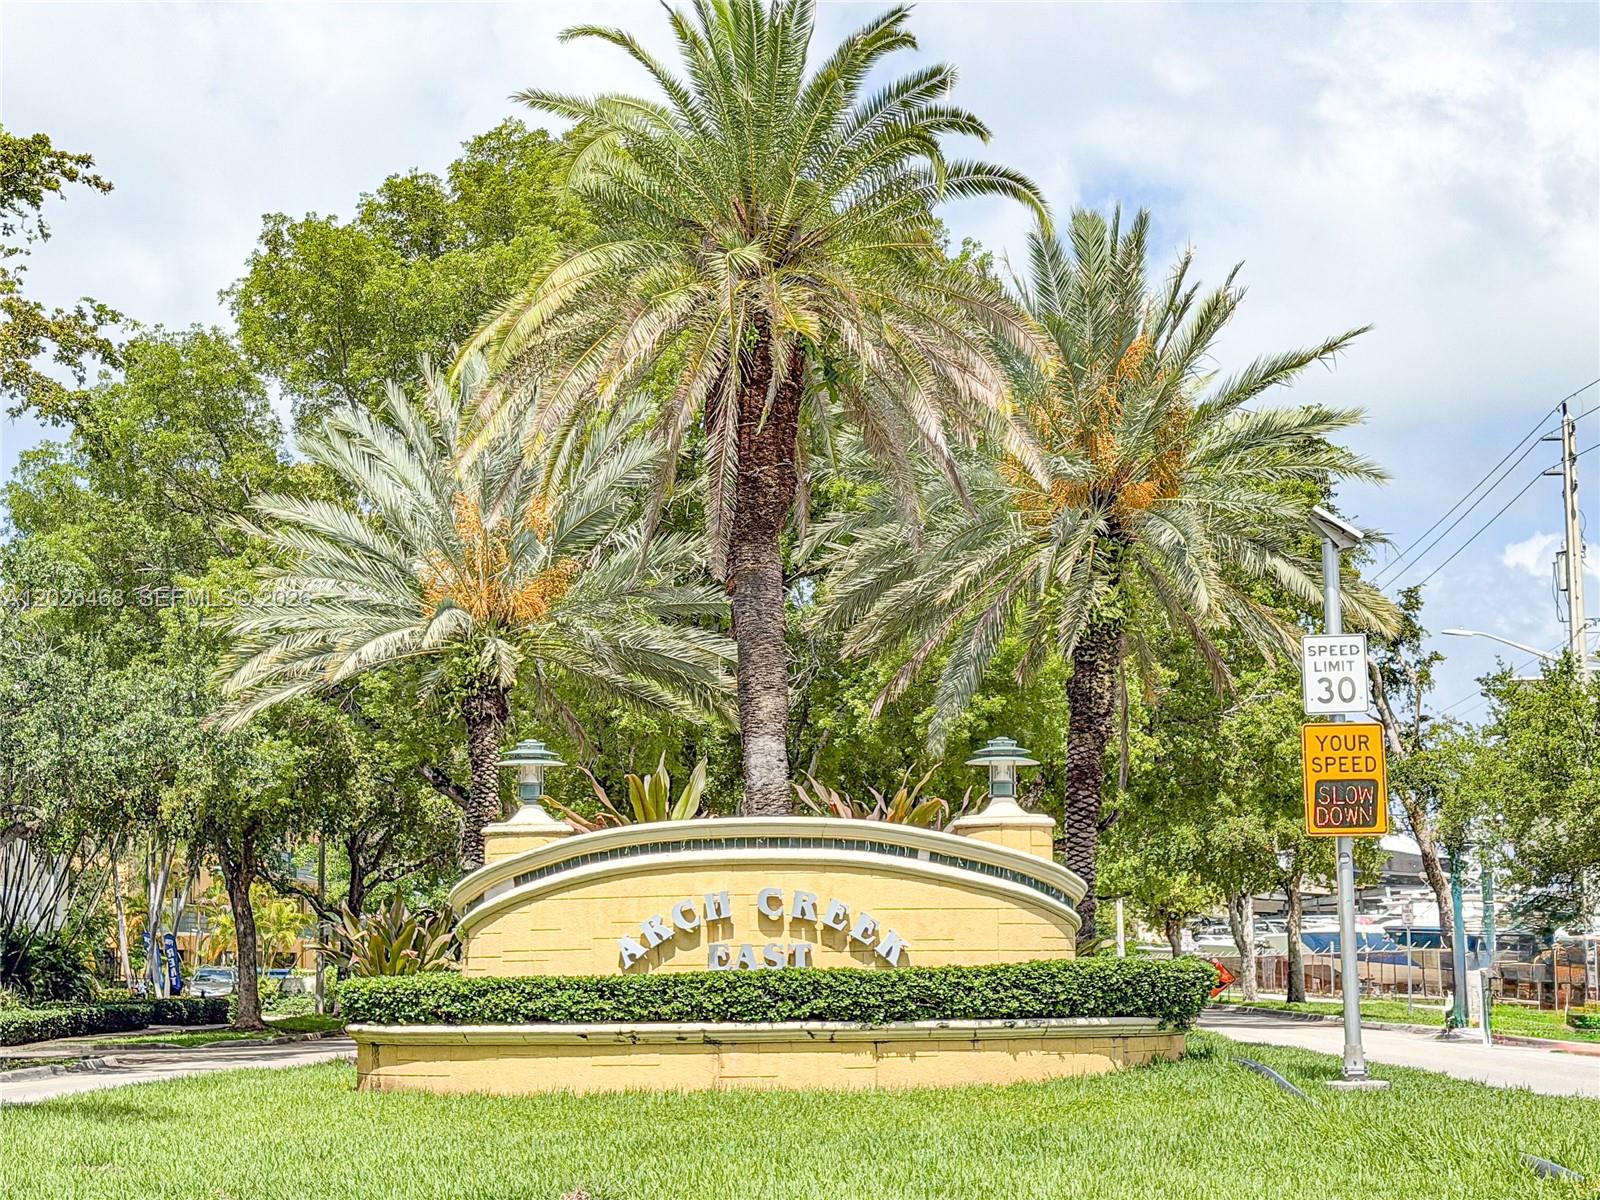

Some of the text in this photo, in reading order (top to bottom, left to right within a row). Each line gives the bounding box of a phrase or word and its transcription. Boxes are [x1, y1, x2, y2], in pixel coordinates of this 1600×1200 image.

[1307, 644, 1361, 657] SPEED
[1313, 660, 1356, 673] LIMIT
[1317, 676, 1356, 704] 30
[1315, 734, 1370, 752] YOUR
[1311, 756, 1377, 773] SPEED
[1318, 785, 1374, 805] SLOW
[1316, 805, 1373, 826] DOWN
[617, 887, 909, 970] ARCH CREEK
[707, 943, 813, 971] EAST
